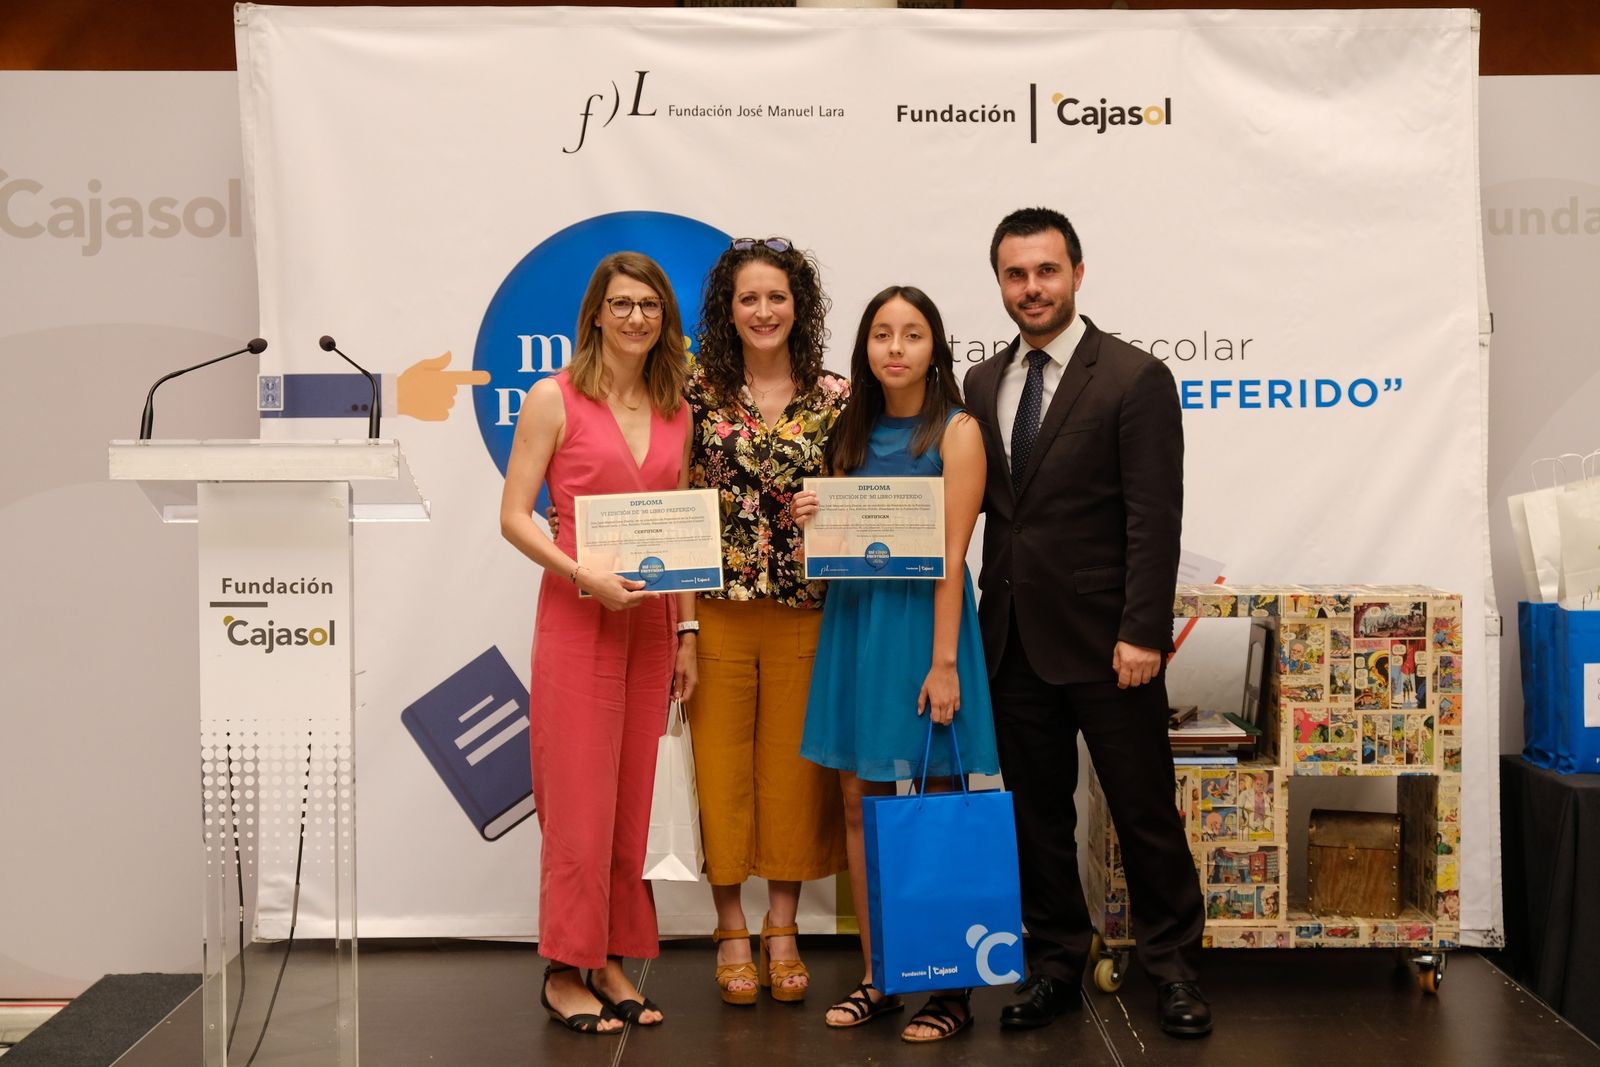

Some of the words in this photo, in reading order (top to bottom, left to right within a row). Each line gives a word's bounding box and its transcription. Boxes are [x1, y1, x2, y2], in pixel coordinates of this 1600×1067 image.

[668, 105, 732, 117] Fundación
[737, 105, 763, 117] José
[768, 105, 814, 117] Manuel
[819, 105, 845, 117] Lara
[896, 104, 1016, 122] Fundación
[1055, 97, 1171, 134] Cajasol
[0, 178, 242, 257] Cajasol
[1107, 331, 1253, 361] colar
[1181, 378, 1402, 409] EFERIDO”
[630, 499, 663, 507] DIPLOMA
[222, 577, 333, 594] Fundación
[225, 619, 335, 653] Cajasol
[933, 966, 958, 977] Cajasol
